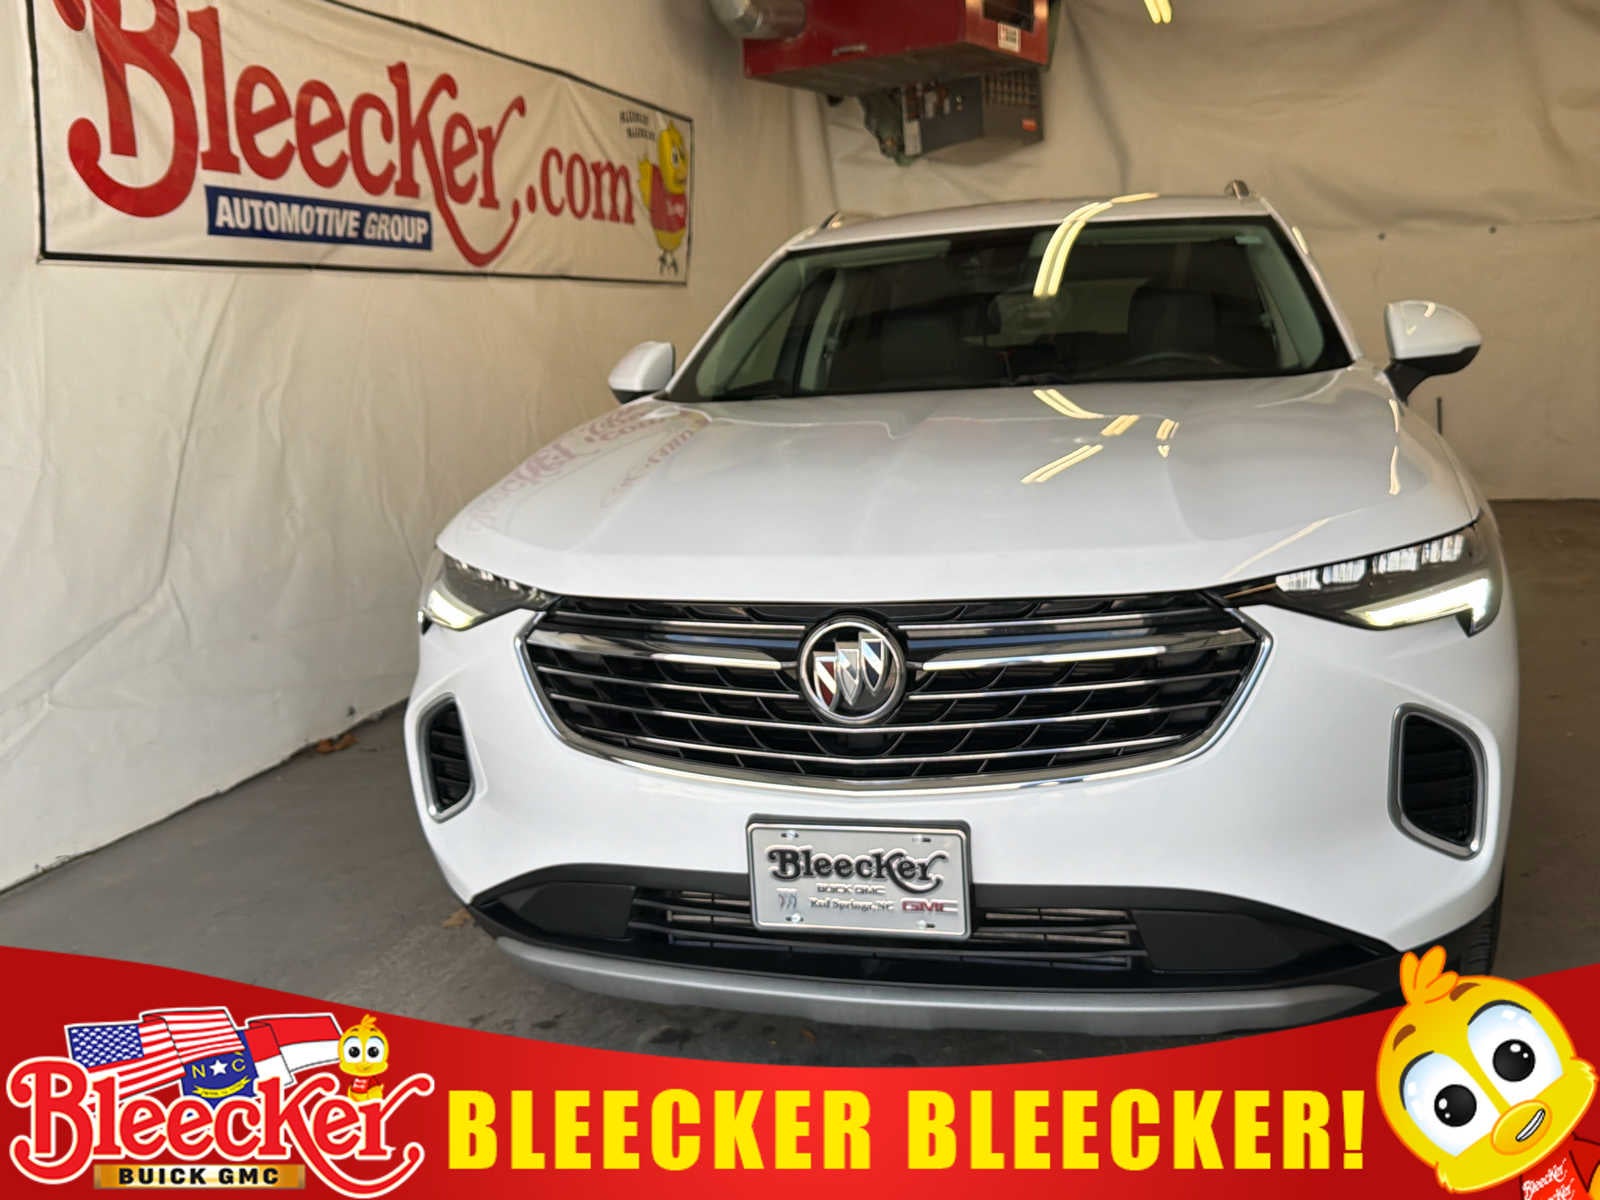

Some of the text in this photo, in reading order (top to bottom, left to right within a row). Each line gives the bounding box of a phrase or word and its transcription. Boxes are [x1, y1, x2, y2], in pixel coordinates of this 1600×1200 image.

[215, 195, 429, 244] AUTOMOTIVE GROUP
[767, 845, 948, 894] Bleecker
[901, 898, 959, 913] GMC
